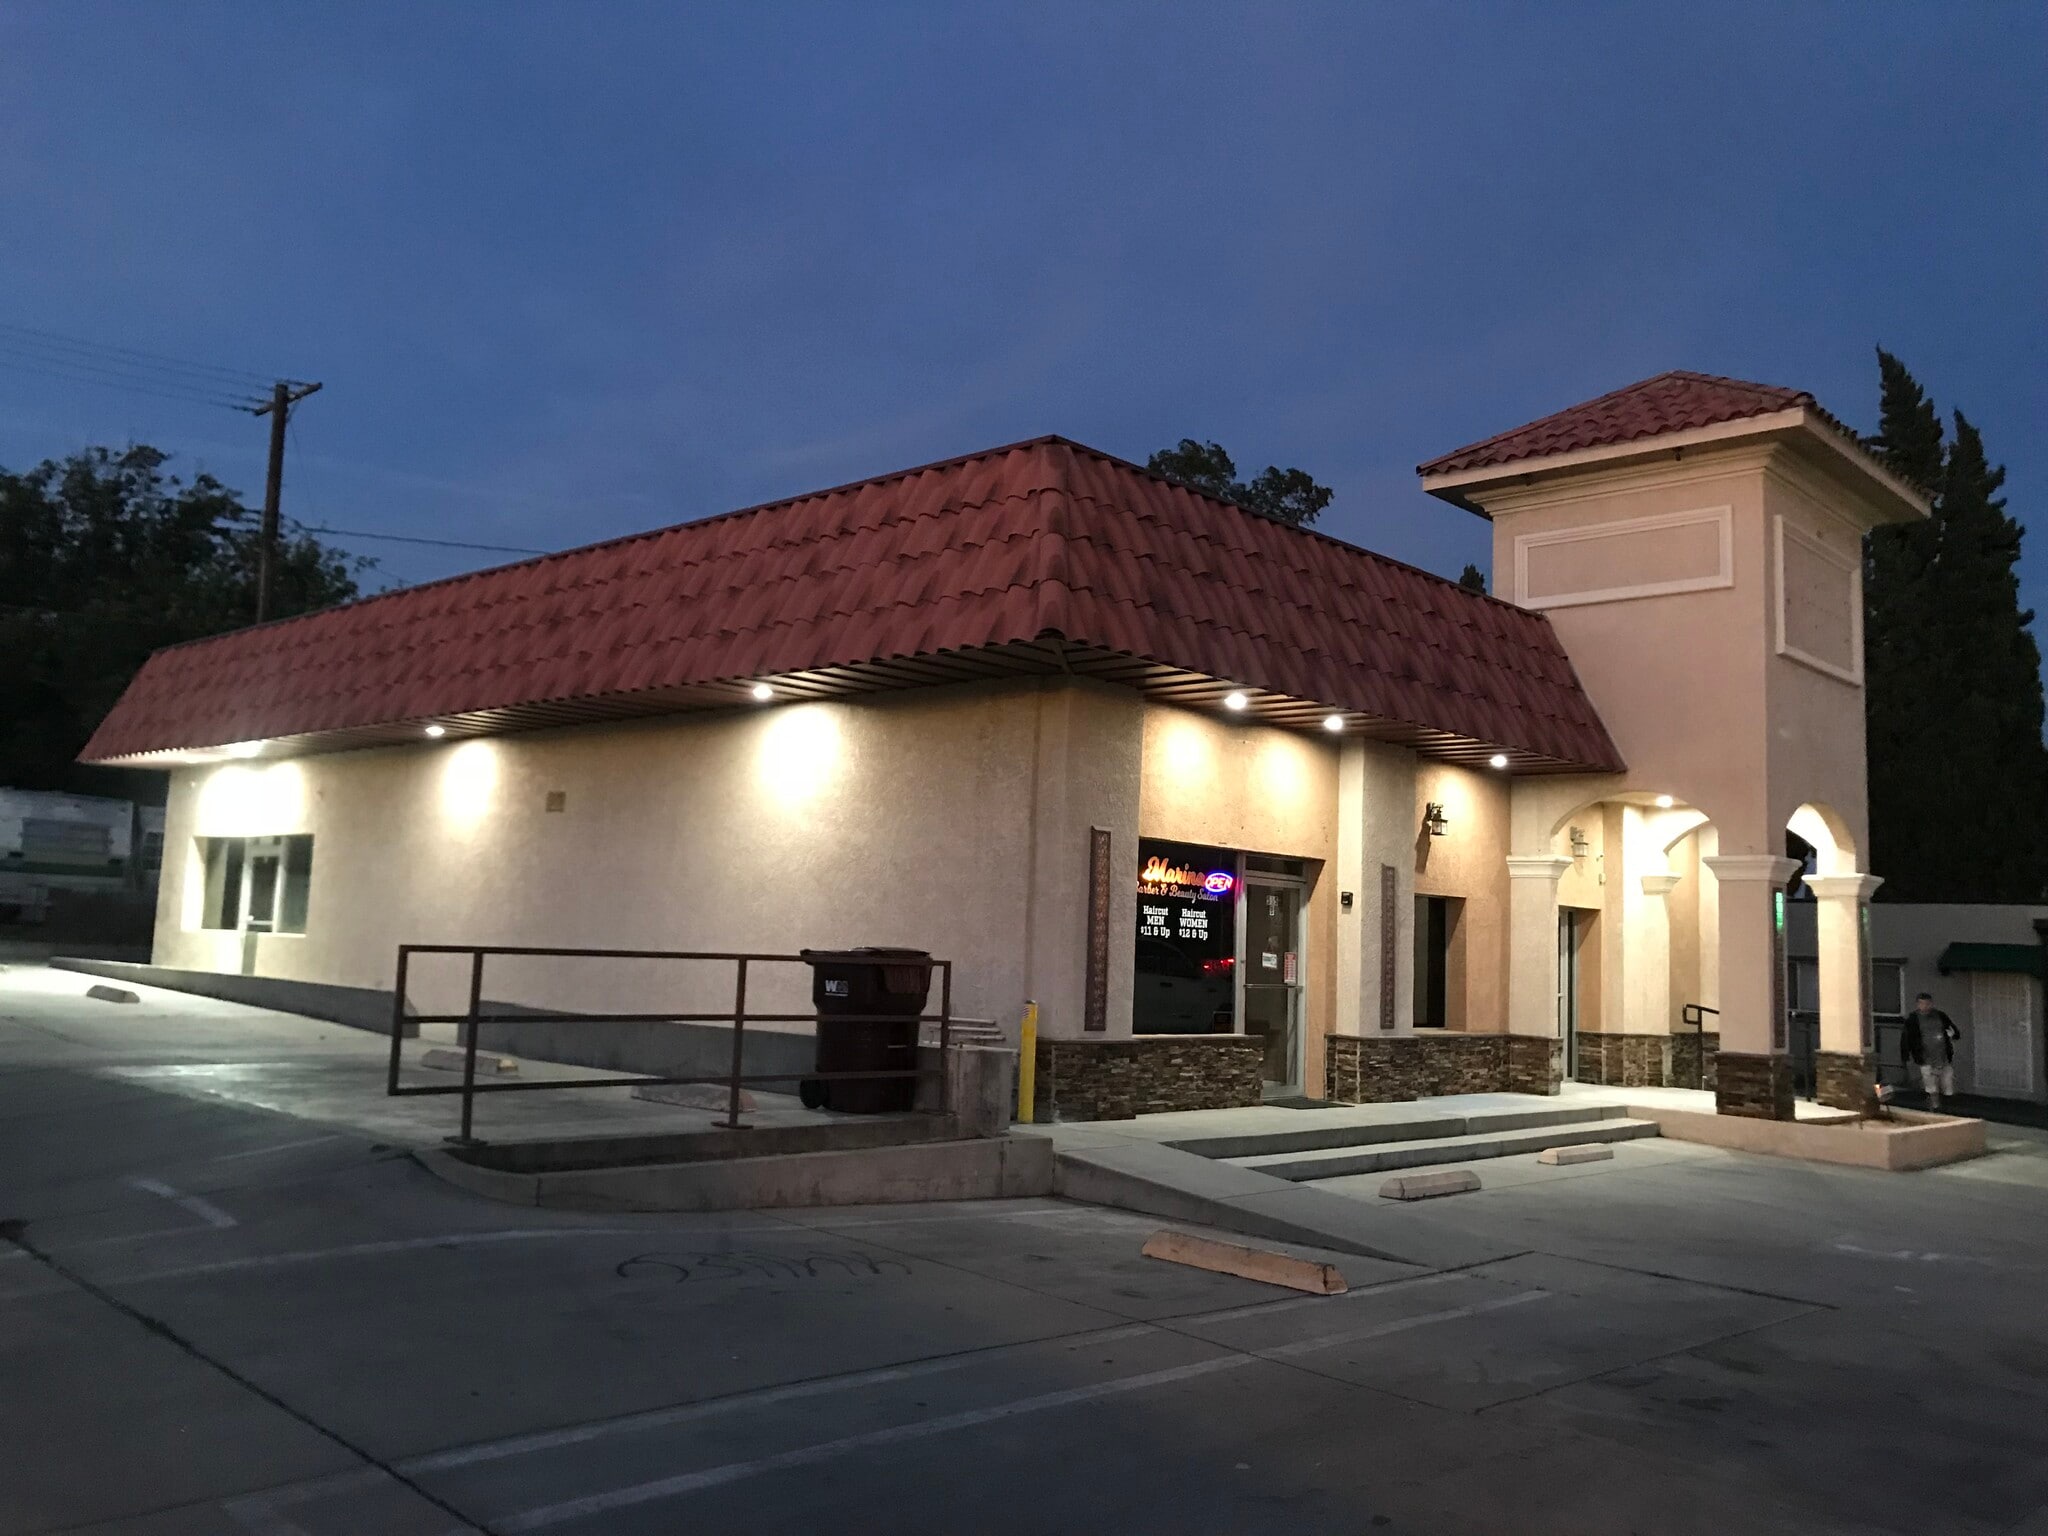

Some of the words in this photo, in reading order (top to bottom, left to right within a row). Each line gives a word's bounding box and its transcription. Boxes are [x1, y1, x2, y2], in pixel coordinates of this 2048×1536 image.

[1142, 856, 1206, 887] Marina
[1206, 876, 1231, 889] OPEN
[1169, 885, 1197, 904] Beauty
[1197, 889, 1218, 901] Salon
[1143, 905, 1168, 915] Haircut
[1181, 908, 1206, 918] Haircut
[1147, 915, 1165, 925] MEN
[1179, 917, 1208, 928] WOMEN
[1140, 926, 1152, 936] $11
[1160, 926, 1171, 938] Up
[1179, 928, 1191, 938] $12
[1198, 929, 1208, 940] Up
